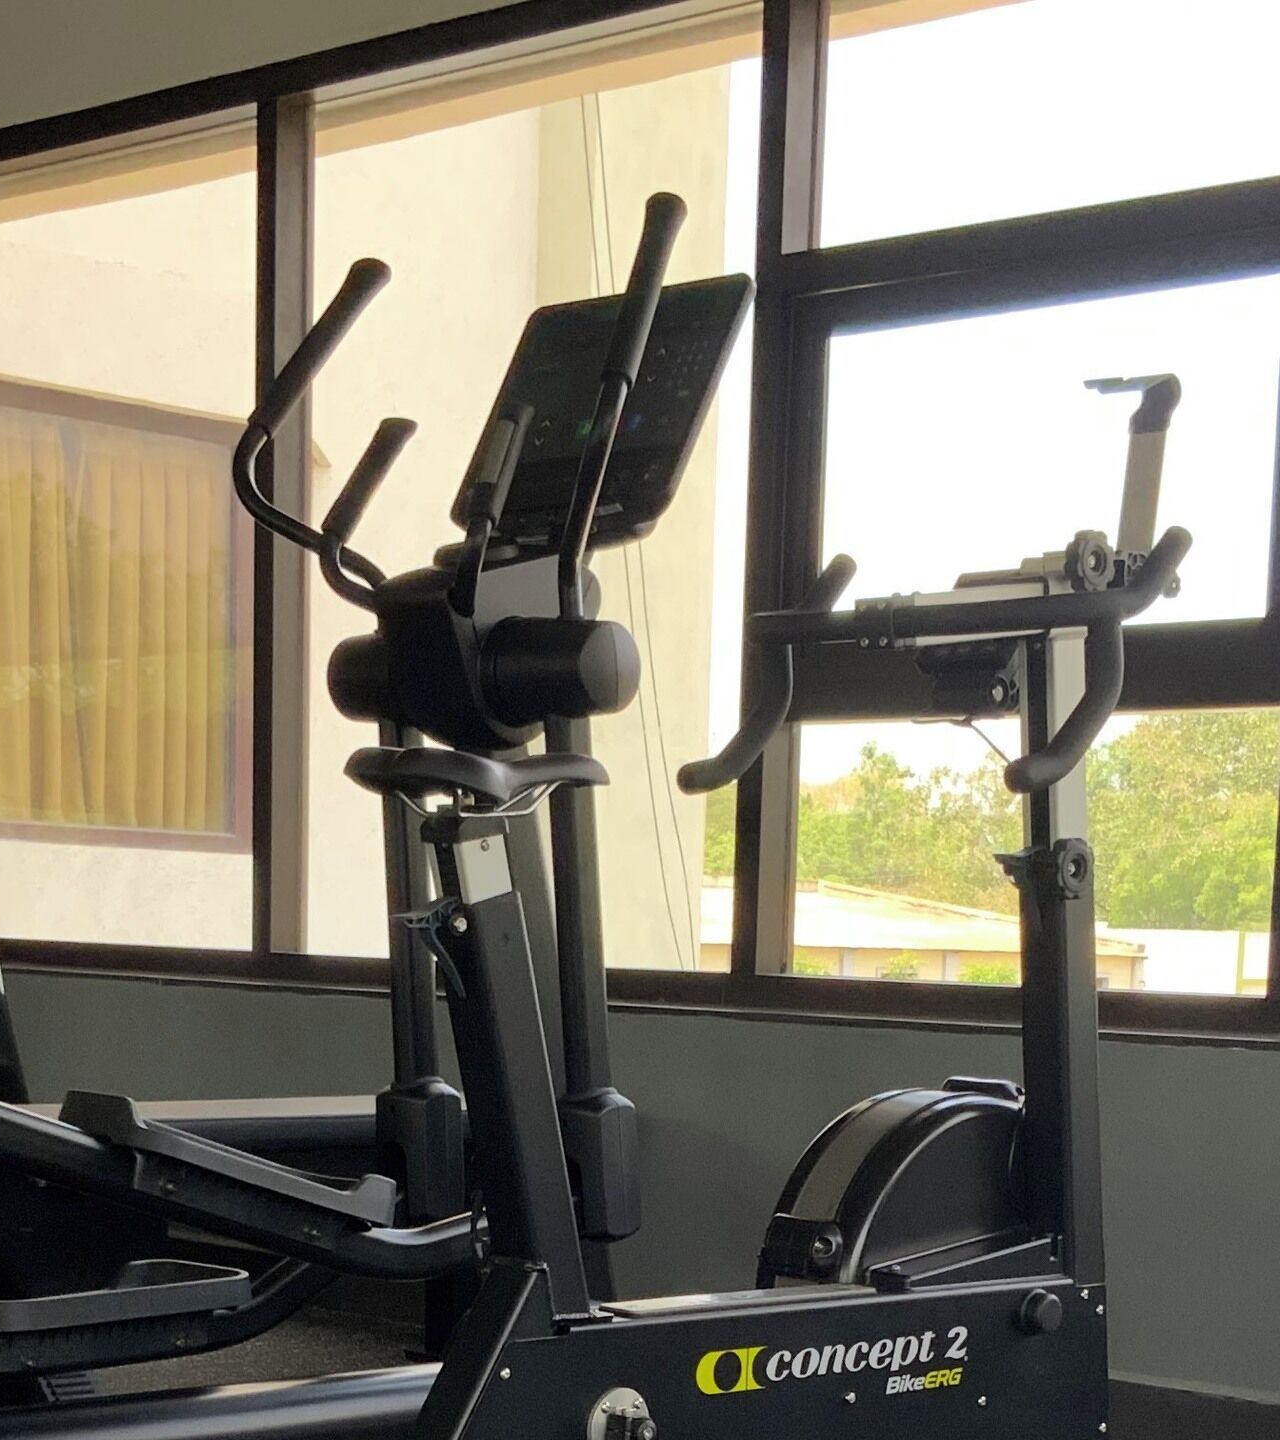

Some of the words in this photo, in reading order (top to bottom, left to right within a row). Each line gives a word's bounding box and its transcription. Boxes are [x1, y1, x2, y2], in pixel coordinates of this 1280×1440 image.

[766, 1330, 936, 1382] concept
[944, 1326, 968, 1360] 2
[885, 1367, 964, 1395] BikeERG
